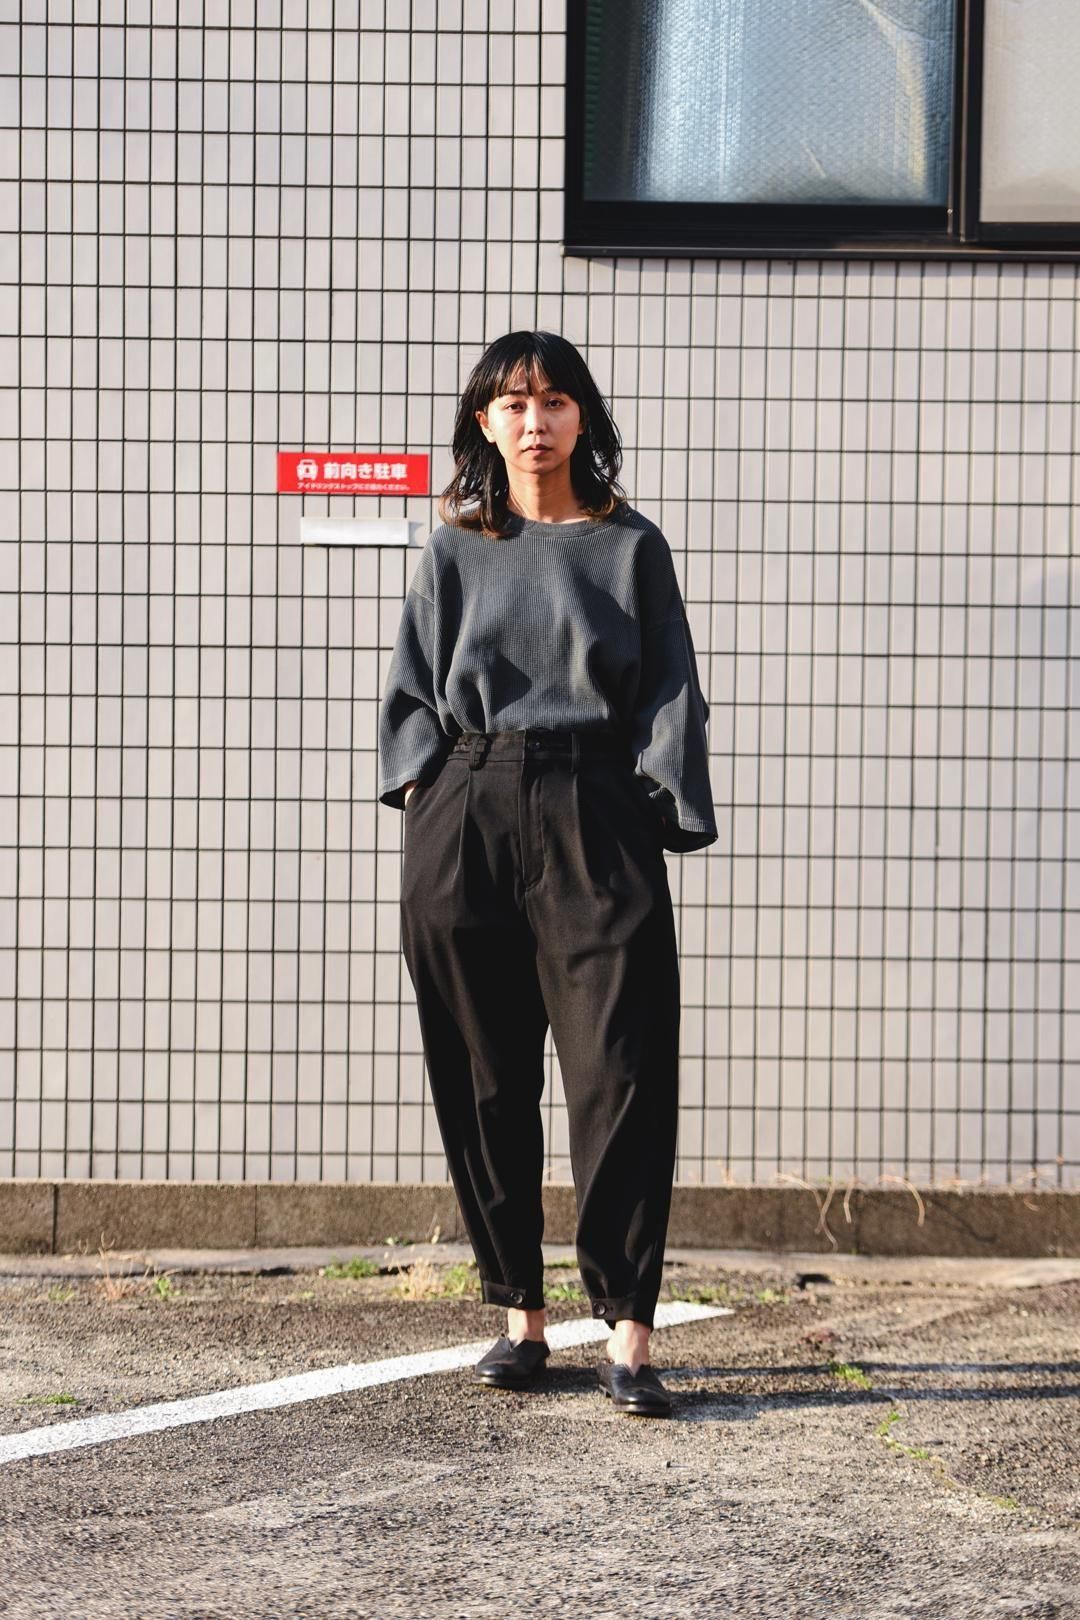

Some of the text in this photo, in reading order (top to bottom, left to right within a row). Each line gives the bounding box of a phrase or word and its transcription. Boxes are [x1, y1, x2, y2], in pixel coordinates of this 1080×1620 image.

[323, 463, 407, 480] 前向き駐車
